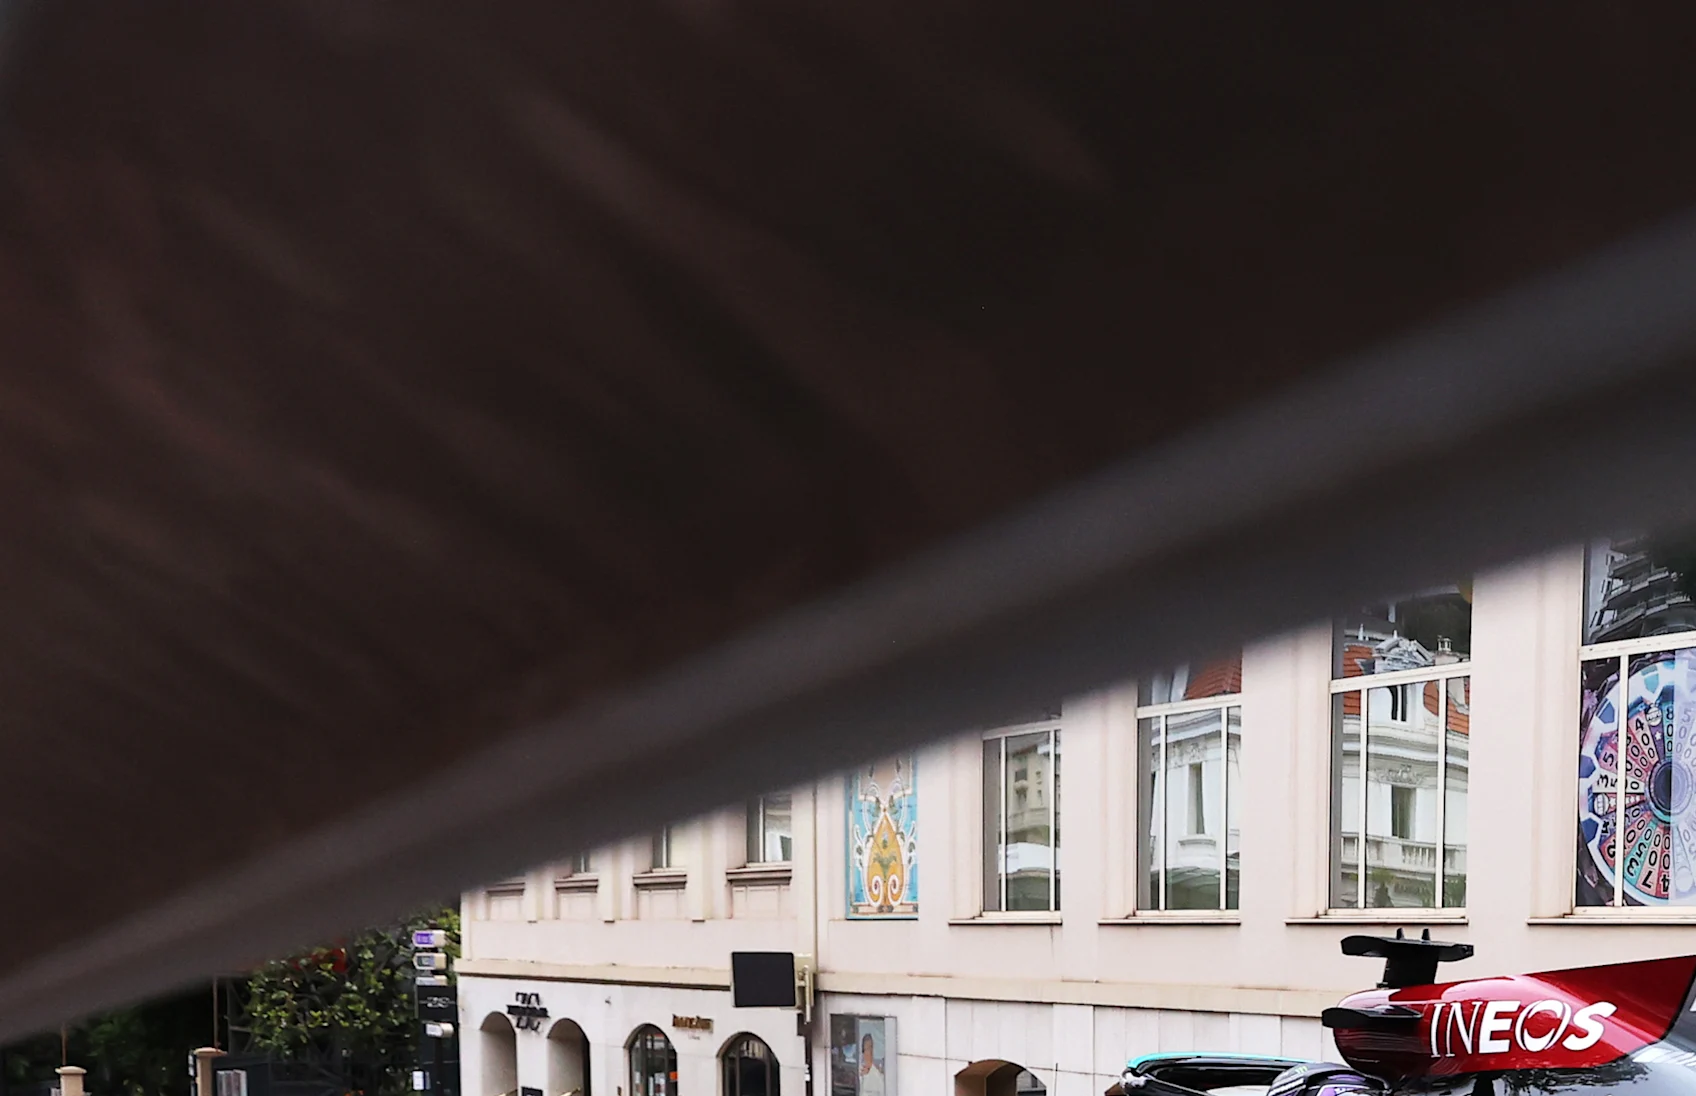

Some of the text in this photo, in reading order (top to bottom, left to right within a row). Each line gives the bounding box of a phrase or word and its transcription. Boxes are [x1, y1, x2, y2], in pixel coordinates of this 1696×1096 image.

[1635, 718, 1655, 758] 400
[1642, 834, 1661, 888] 700
[1430, 1000, 1617, 1057] INEOS
